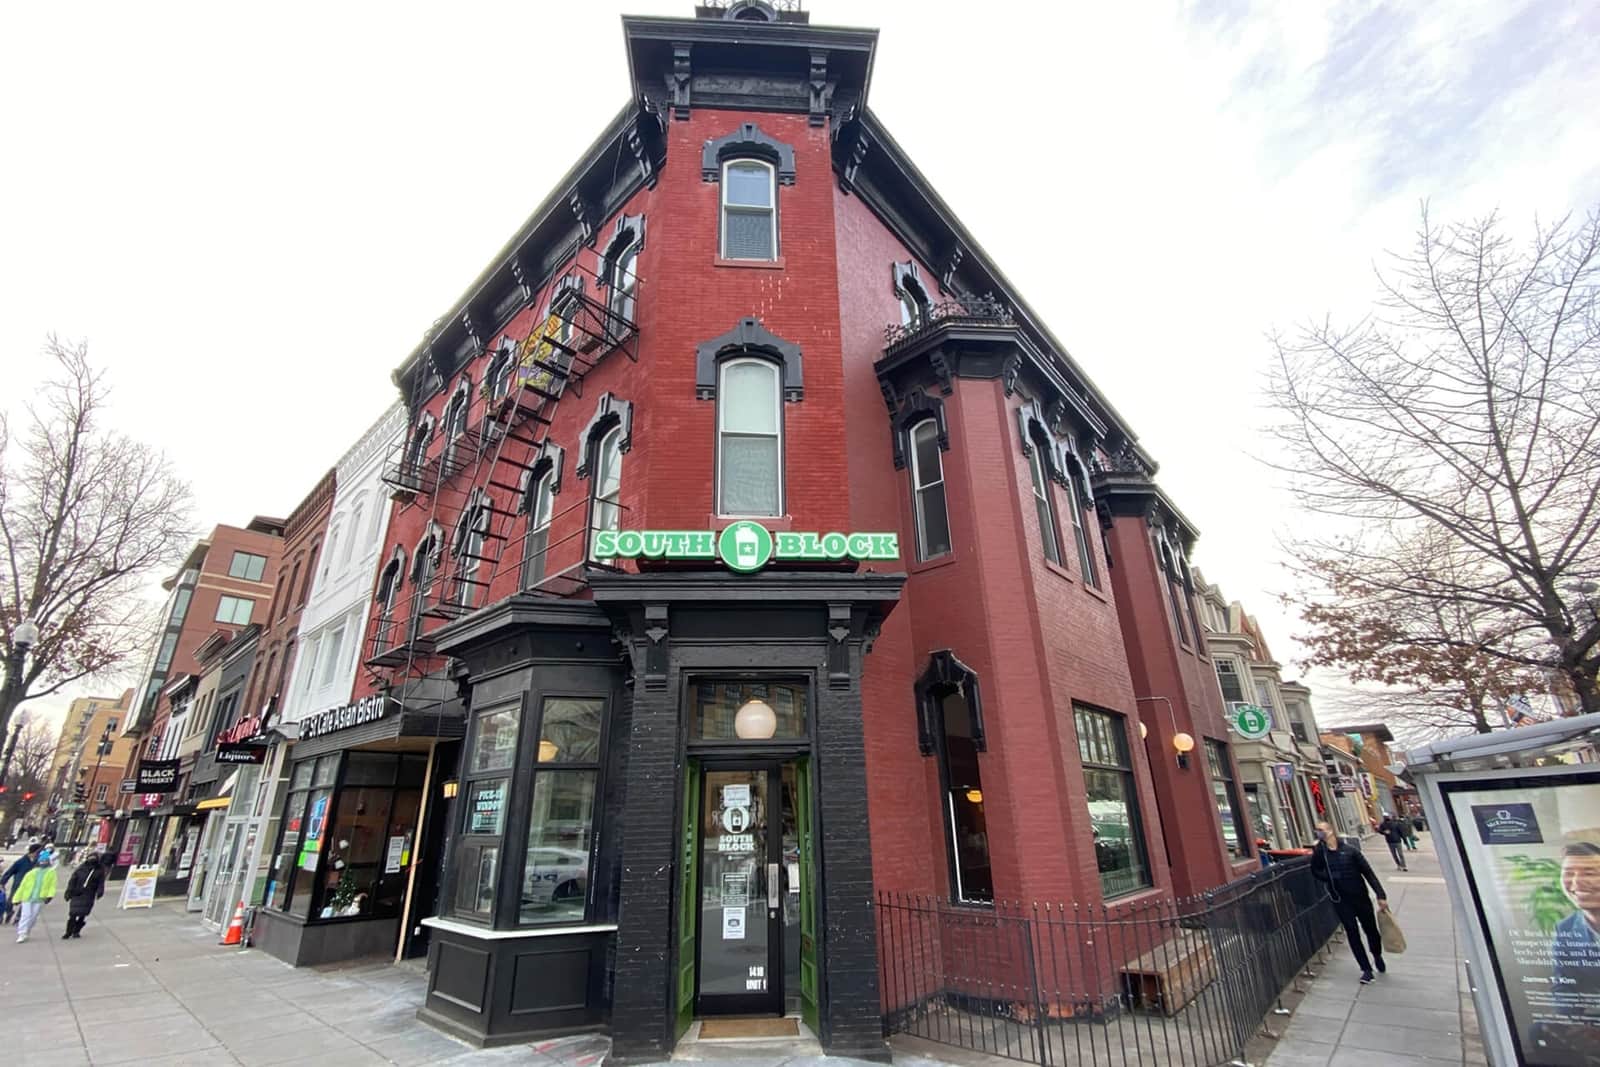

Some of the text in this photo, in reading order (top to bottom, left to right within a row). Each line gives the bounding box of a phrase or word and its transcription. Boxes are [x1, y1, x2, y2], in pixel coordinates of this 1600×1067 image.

[594, 531, 899, 560] SOUTH BLOCK
[357, 694, 384, 724] Bistro
[141, 768, 175, 778] BLACK
[141, 777, 174, 785] WHISKEY
[720, 835, 753, 843] SOUTH
[719, 843, 754, 852] BLOCK
[746, 979, 762, 991] UNIT
